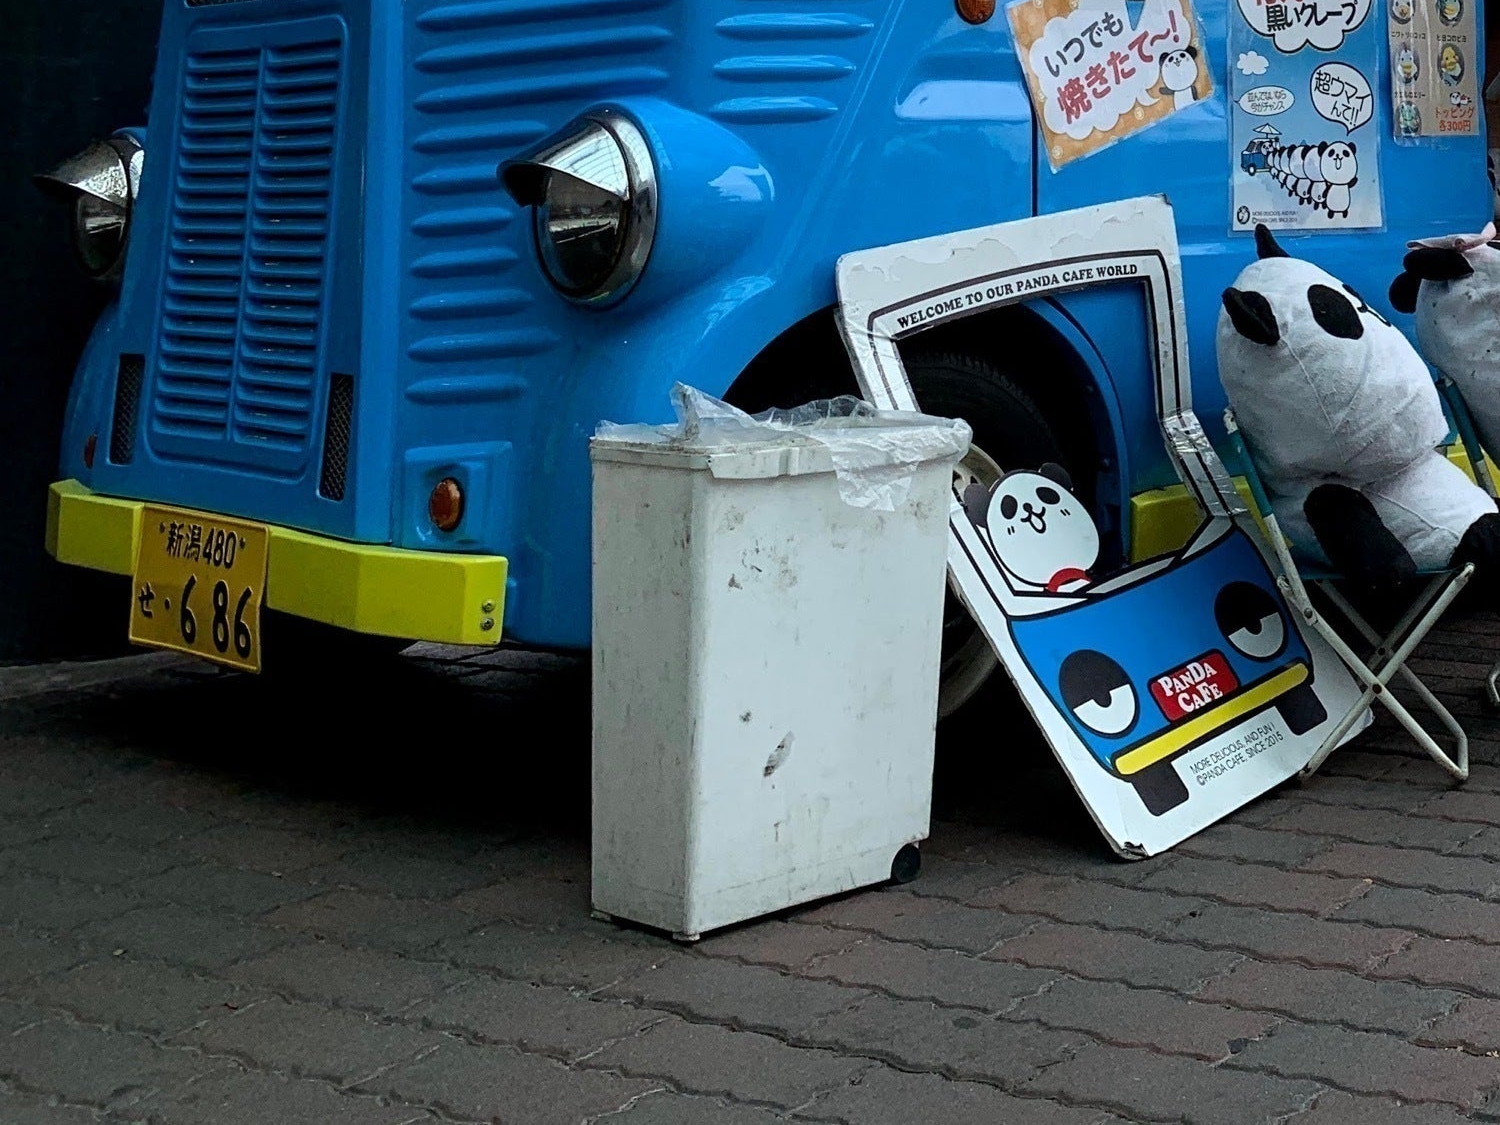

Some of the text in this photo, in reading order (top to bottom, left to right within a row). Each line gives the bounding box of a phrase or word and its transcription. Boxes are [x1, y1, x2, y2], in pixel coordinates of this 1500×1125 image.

[1266, 0, 1358, 32] 黒いクレープ
[1044, 12, 1123, 77] いつでも
[1250, 100, 1286, 113] 今がチャンス
[1314, 69, 1371, 112] 超ウマイ
[1435, 106, 1475, 119] トッピング
[1439, 120, 1471, 132] 各300円
[896, 263, 1138, 329] WELCOME TO OUR PANDA CAFE WORLD
[138, 583, 155, 618] せ
[1157, 661, 1218, 697] PANDA
[1177, 681, 1224, 713] CAFE
[1189, 757, 1213, 775] MORE
[1211, 739, 1245, 764] DELICIOUS,
[1243, 730, 1261, 747] AND
[1245, 741, 1268, 758] SINCE
[1264, 732, 1284, 748] 2015
